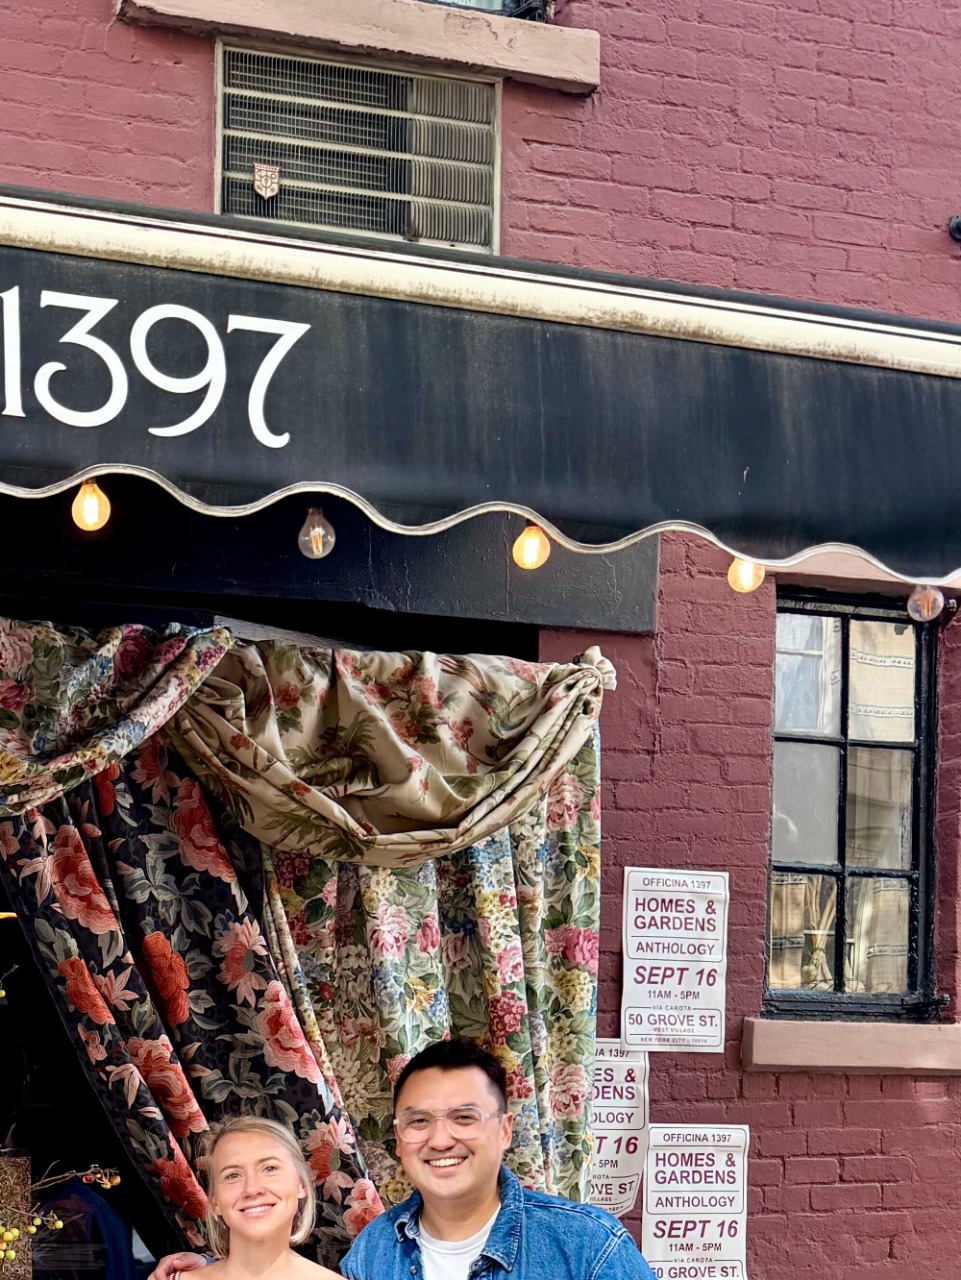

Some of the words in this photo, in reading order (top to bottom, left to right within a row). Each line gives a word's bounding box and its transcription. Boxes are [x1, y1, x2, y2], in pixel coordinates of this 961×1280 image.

[642, 877, 688, 888] OFFICINA
[691, 880, 711, 890] 1397
[635, 897, 695, 914] HOMES
[705, 900, 716, 915] &
[634, 915, 716, 932] GARDENS
[635, 941, 715, 956] ANTHOLOGY
[633, 965, 689, 986] SEPT
[695, 968, 718, 987] 16
[647, 990, 672, 999] 11AM
[680, 990, 700, 1000] 5PM
[628, 1013, 643, 1025] 50
[647, 1013, 695, 1026] GROVE
[699, 1015, 718, 1027] ST.
[624, 1068, 636, 1083] &
[613, 1136, 639, 1154] 16
[663, 1133, 709, 1143] OFFICINA
[711, 1134, 732, 1143] 1397
[598, 1160, 618, 1169] 5PM
[655, 1152, 715, 1167] HOMES
[725, 1153, 736, 1167] &
[655, 1170, 737, 1185] GARDENS
[655, 1196, 735, 1208] ANTHOLOGY
[653, 1220, 711, 1239] SEPT
[717, 1220, 738, 1238] 16
[669, 1243, 694, 1252] 11AM
[702, 1243, 722, 1251] 5PM
[668, 1266, 716, 1278] GROVE
[720, 1266, 739, 1278] ST.
